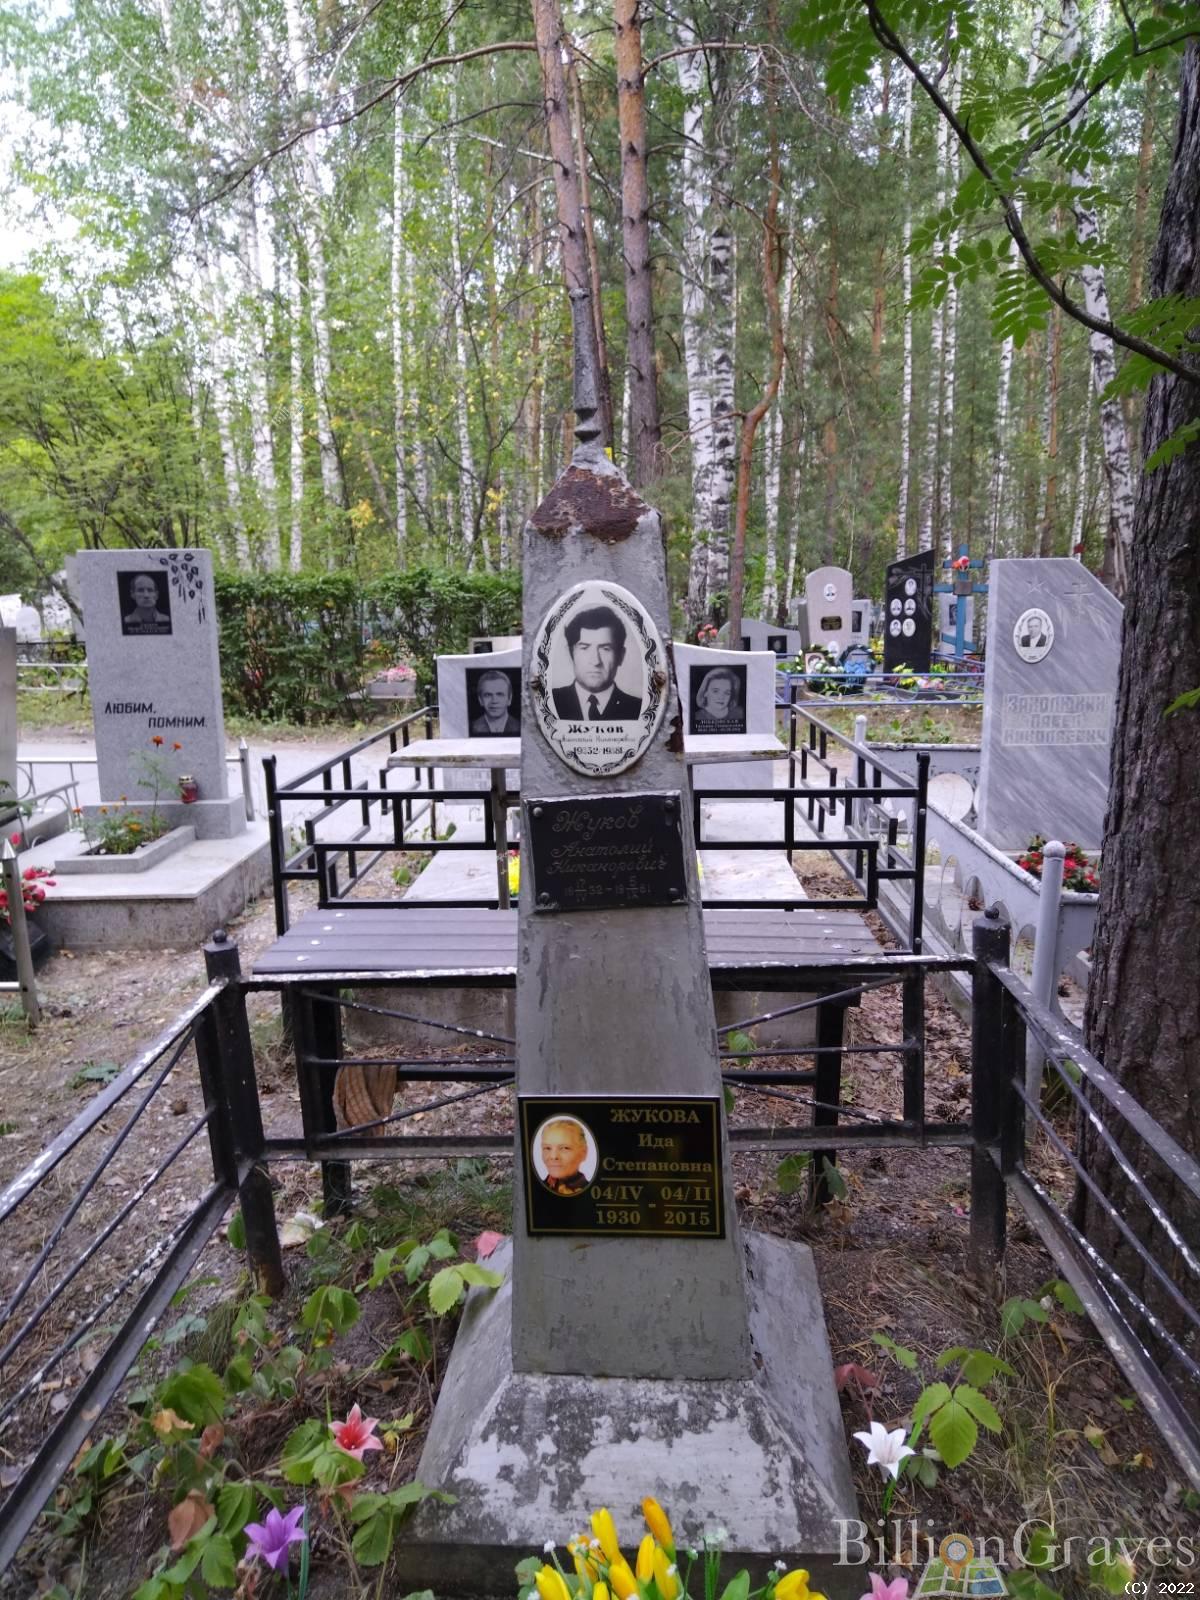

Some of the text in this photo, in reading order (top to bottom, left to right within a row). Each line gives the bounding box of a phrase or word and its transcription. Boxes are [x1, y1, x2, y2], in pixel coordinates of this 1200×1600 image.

[104, 702, 157, 714] ЛЮБИМ,
[148, 716, 208, 729] ПОМНИМ.
[552, 804, 645, 840] Жуков
[610, 1109, 700, 1123] ЖУКОВА
[638, 1133, 675, 1149] Ида
[602, 1157, 712, 1173] Степановна
[590, 1185, 644, 1200] 04/IV
[596, 1210, 711, 1226] 1930 2015
